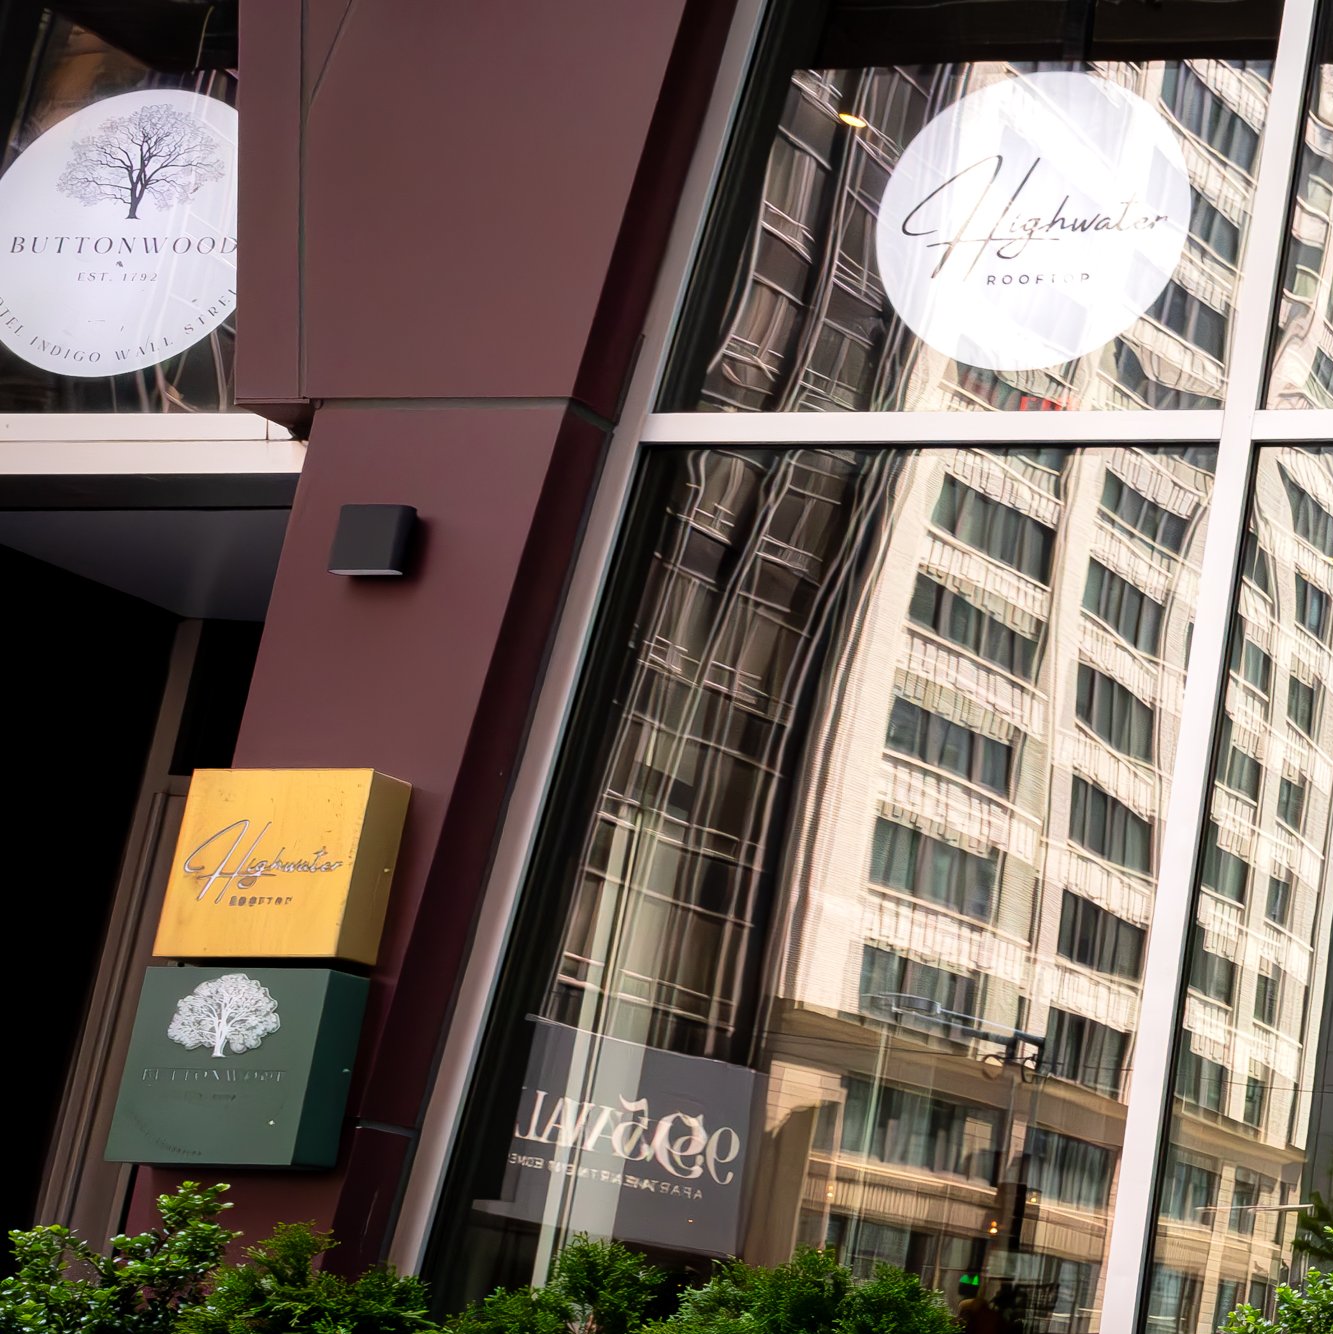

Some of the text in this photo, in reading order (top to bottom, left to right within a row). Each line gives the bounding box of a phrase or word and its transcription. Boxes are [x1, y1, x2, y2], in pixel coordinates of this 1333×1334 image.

[902, 155, 1168, 281] Highwater
[10, 236, 237, 254] BUTTONWOOD
[77, 272, 158, 281] EST. 1792
[987, 273, 1090, 285] ROOFTOP
[29, 335, 101, 362] INDIGO
[184, 819, 343, 904] Highwater
